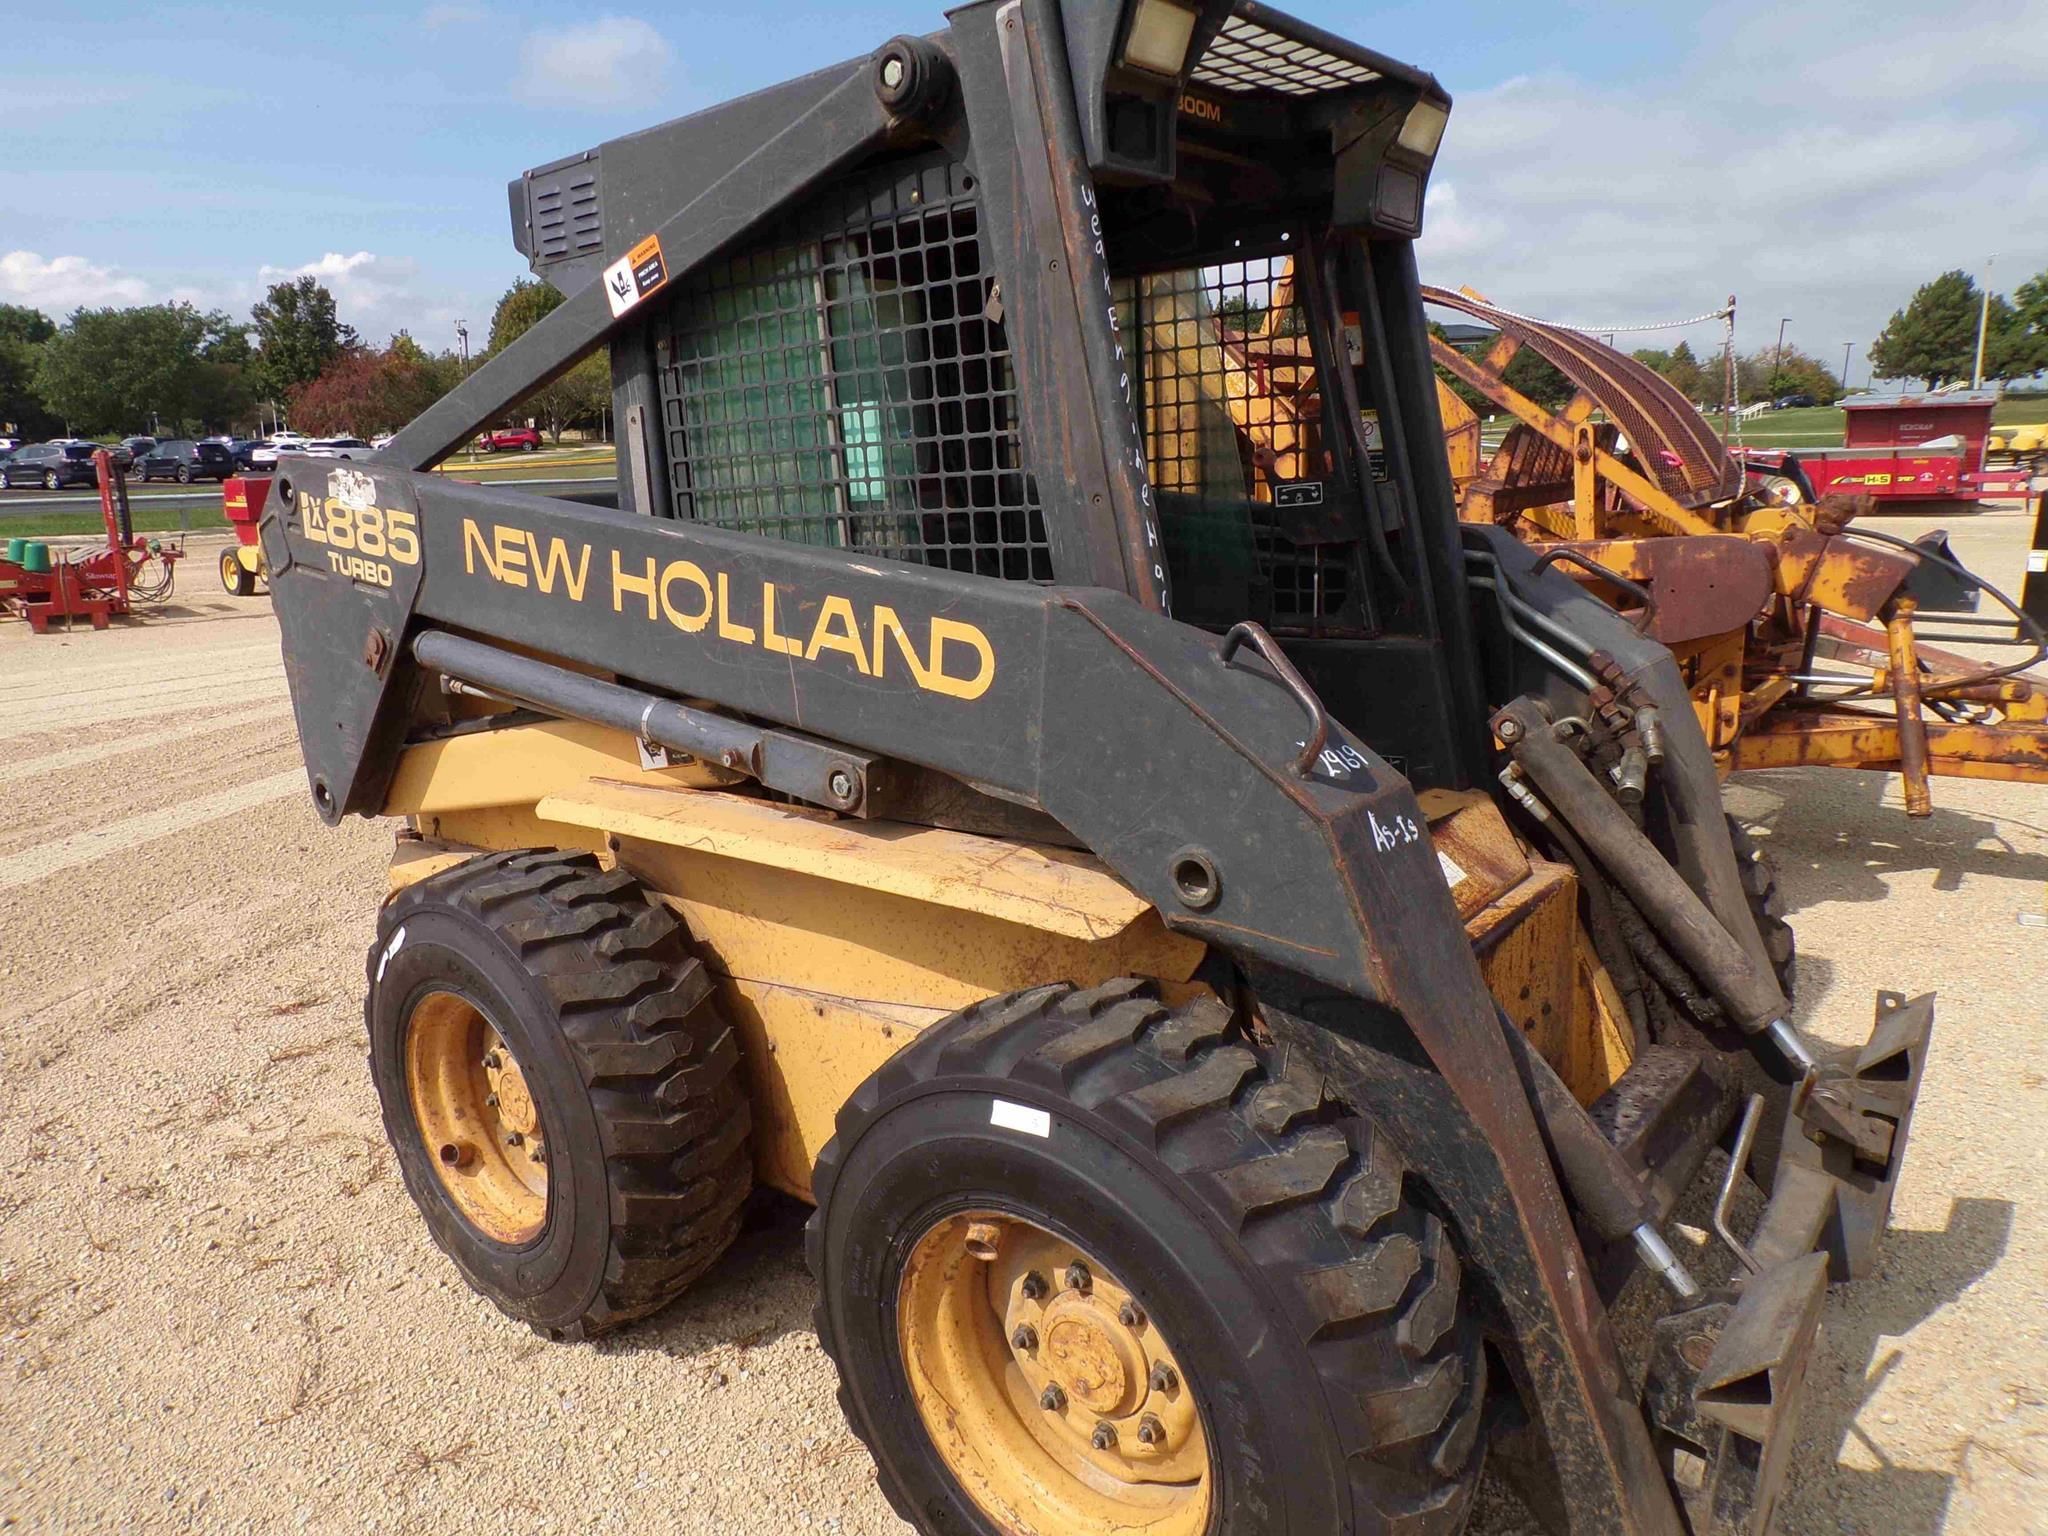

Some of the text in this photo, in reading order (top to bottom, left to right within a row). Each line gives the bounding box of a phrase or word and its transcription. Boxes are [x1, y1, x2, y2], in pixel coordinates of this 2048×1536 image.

[327, 551, 392, 588] TURBO
[463, 518, 996, 702] NEW HOLLAND
